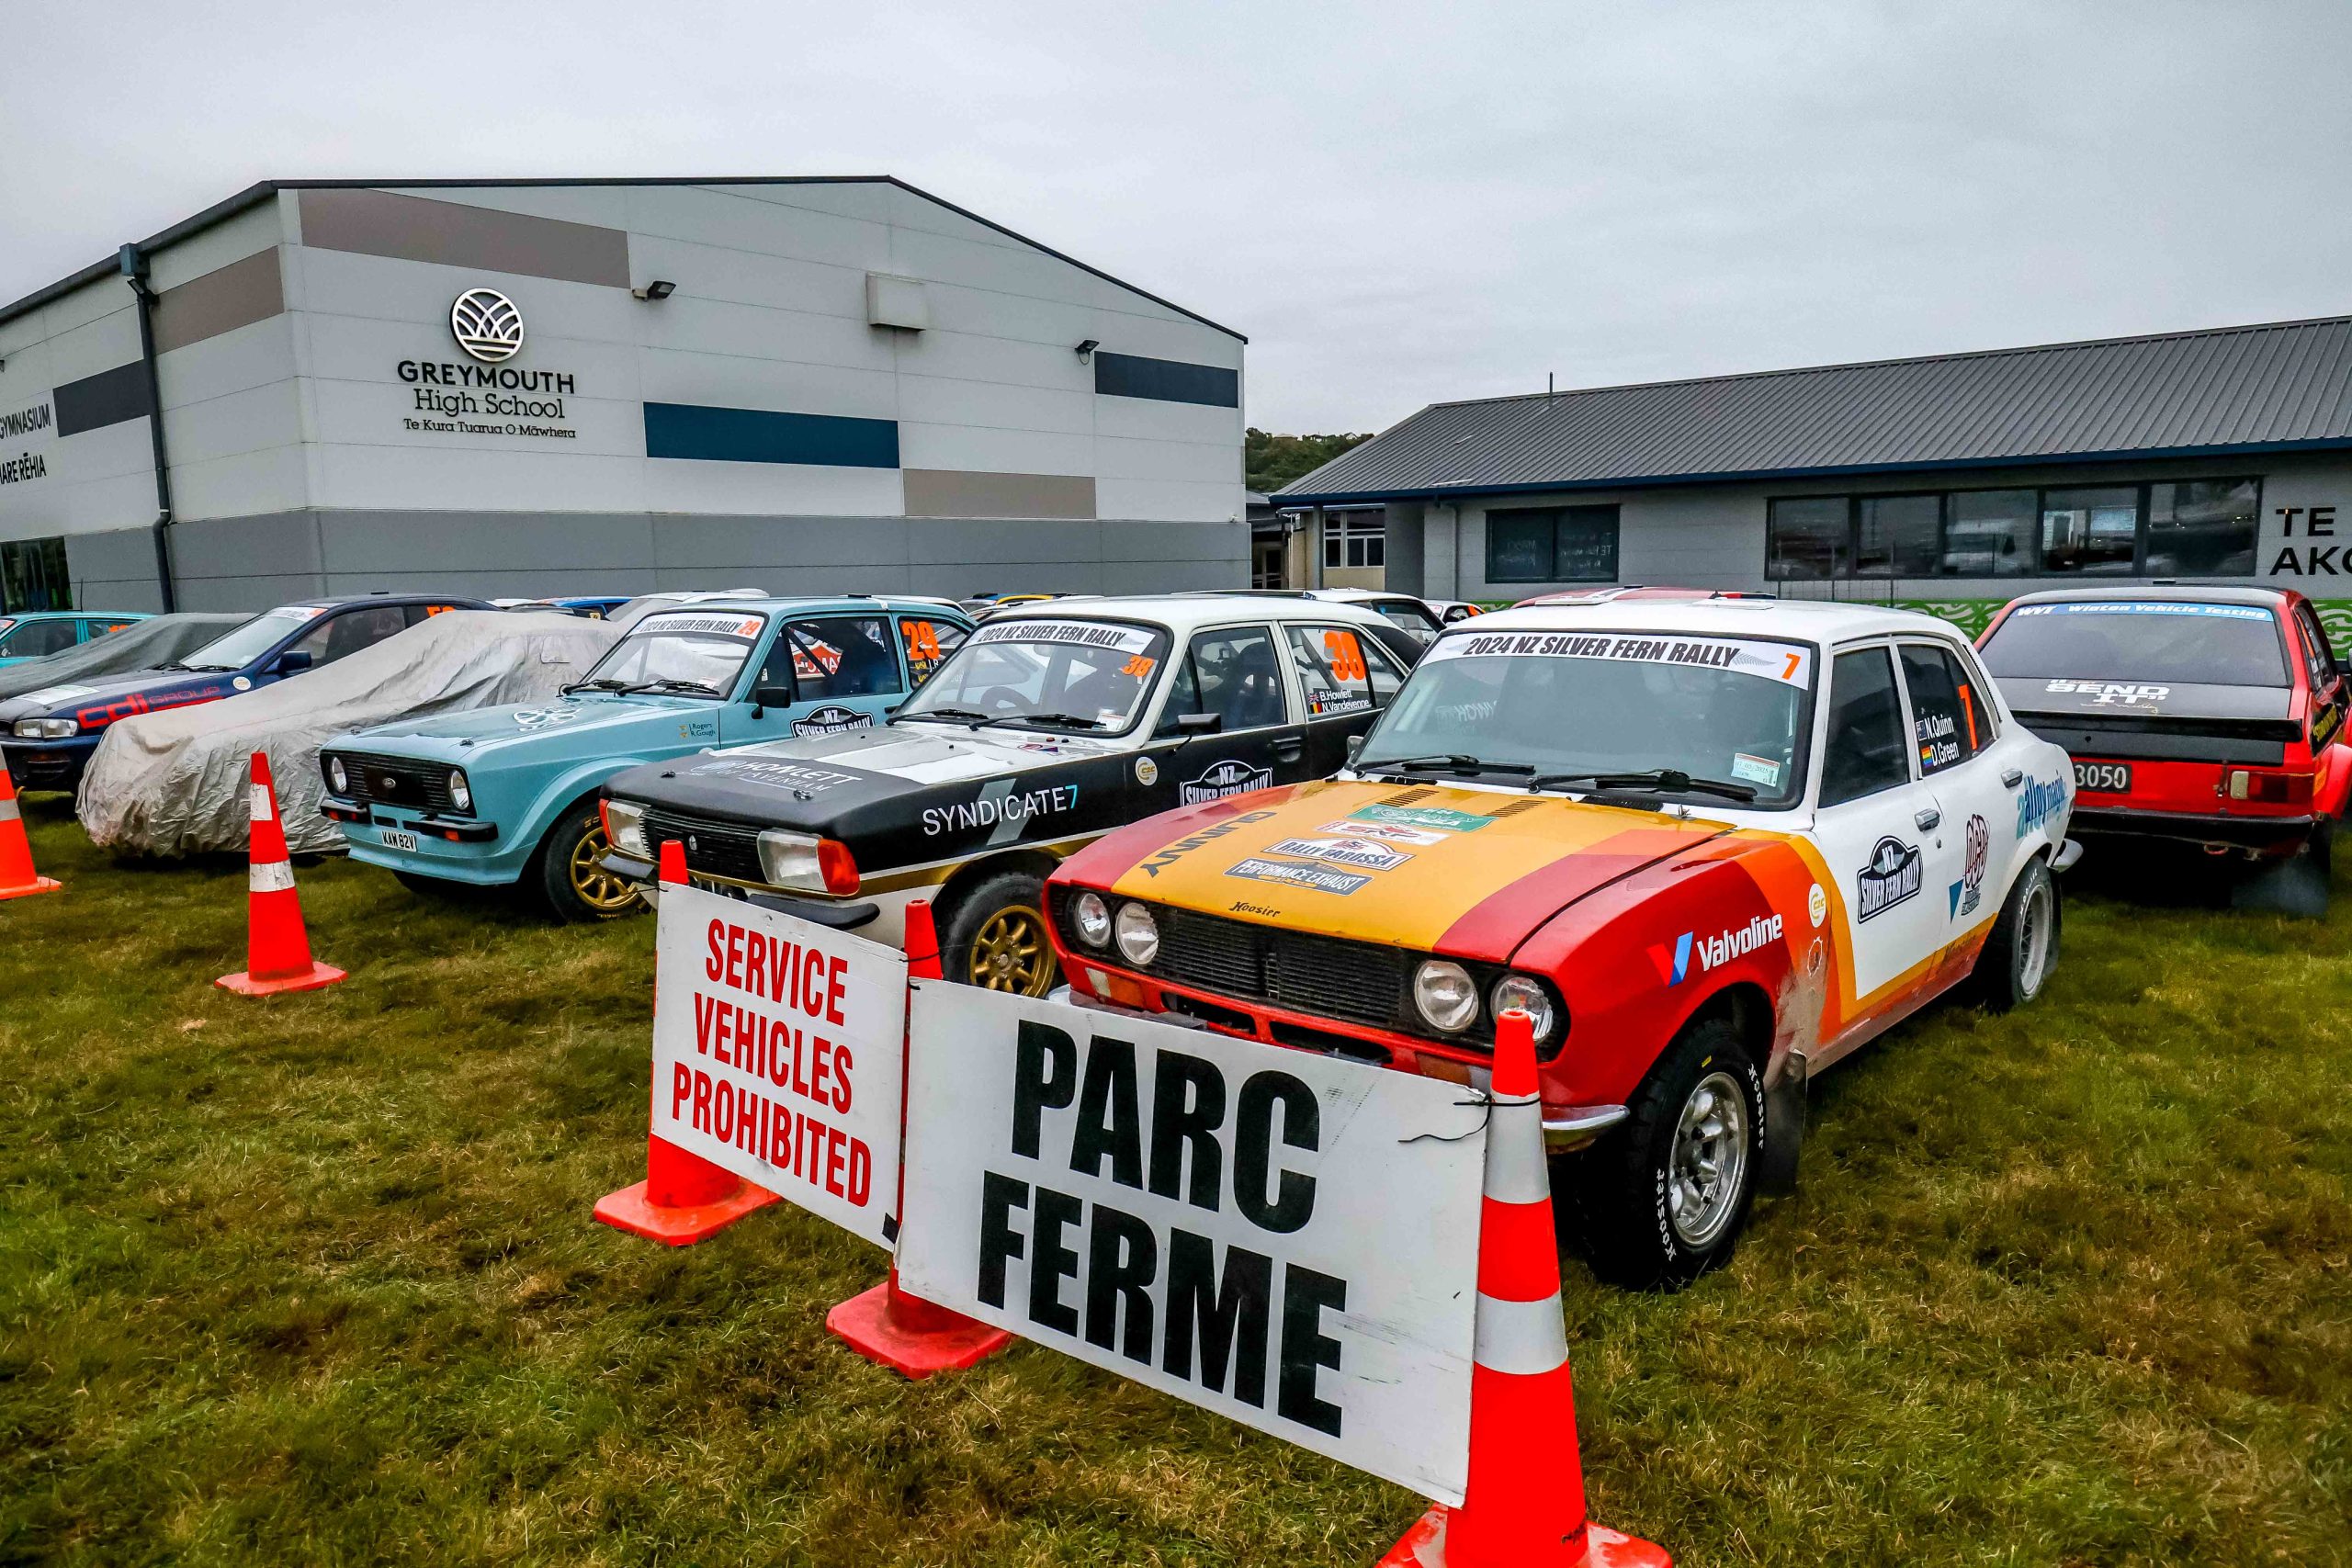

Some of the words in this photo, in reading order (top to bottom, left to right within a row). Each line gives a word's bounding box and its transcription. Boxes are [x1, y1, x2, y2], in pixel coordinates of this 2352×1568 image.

[398, 360, 575, 394] GREYMOUTH
[413, 388, 479, 417] High
[485, 393, 565, 419] School
[403, 418, 420, 430] Te
[424, 419, 455, 432] Kura
[458, 422, 503, 434] Tuarua
[505, 423, 516, 434] O
[519, 424, 576, 438] Māwhera
[0, 460, 18, 484] ARE
[19, 452, 47, 480] RĒHIA
[2276, 506, 2336, 537] TE
[669, 619, 693, 631] SILVER
[692, 619, 715, 632] FERN
[713, 620, 742, 634] RALLY
[2018, 605, 2057, 616] WVT
[2068, 604, 2130, 613] Winton
[2135, 604, 2199, 614] Vehicle
[2205, 606, 2267, 619] Testing
[738, 620, 761, 637] 29
[902, 620, 941, 660] 29
[978, 626, 1003, 643] 2024
[1003, 625, 1021, 640] NZ
[1018, 625, 1056, 641] SILVER
[1056, 626, 1088, 643] FERN
[1083, 628, 1126, 648] RALLY
[1123, 655, 1154, 677] 38
[1324, 629, 1367, 682] 38
[1463, 636, 1514, 656] 2024
[1513, 637, 1540, 656] NZ
[1539, 637, 1611, 658] SILVER
[1610, 638, 1666, 660] FERN
[1668, 644, 1740, 668] RALLY
[1781, 653, 1801, 680] 7
[149, 685, 220, 705] GROUP
[1319, 688, 1353, 702] B.Howlett
[823, 709, 841, 724] NZ
[1924, 713, 1954, 739] N.Quinn
[1930, 741, 1960, 767] D.Green
[1218, 765, 1236, 784] NZ
[2075, 764, 2127, 789] 3050
[1139, 811, 1278, 878] QUINNY
[1278, 841, 1325, 854] RALLY
[1882, 844, 1897, 874] NZ
[1232, 860, 1308, 882] PERFORMANCE
[1307, 869, 1364, 891] EXHAUST
[1860, 874, 1883, 915] SILVER
[1884, 867, 1903, 905] FERN
[1901, 851, 1920, 898] RALLY
[1228, 901, 1282, 918] Hoosier
[1697, 913, 1782, 972] Valvoline
[706, 918, 848, 1027] SERVICE
[694, 991, 853, 1115] VEHICLES
[672, 1061, 871, 1208] PROHIBITED
[1012, 1019, 1320, 1235] PARC
[977, 1169, 1347, 1439] FERME
